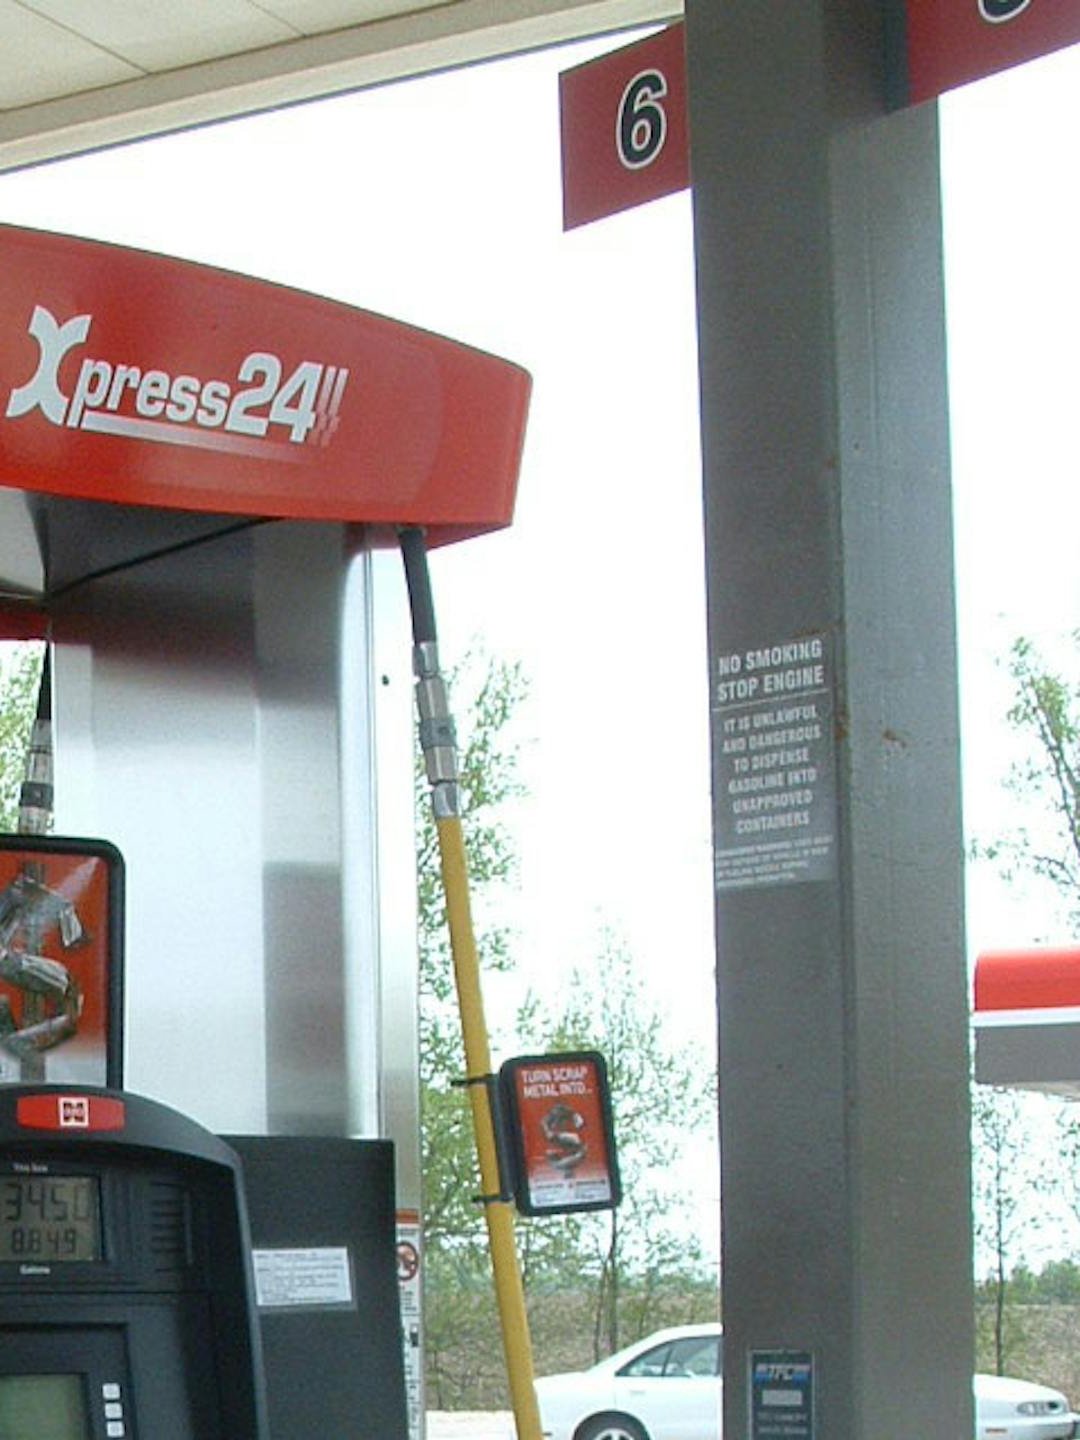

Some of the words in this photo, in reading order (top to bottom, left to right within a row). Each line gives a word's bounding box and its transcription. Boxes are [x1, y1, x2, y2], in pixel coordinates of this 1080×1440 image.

[616, 68, 667, 170] 6
[719, 655, 741, 676] NO
[746, 640, 822, 670] SMOKING
[718, 678, 758, 702] STOP
[764, 665, 824, 693] ENGINE
[753, 705, 817, 729] UNLAWFUL
[723, 737, 746, 753] AND
[749, 725, 821, 750] DANGEROUS
[734, 758, 749, 774] TO
[752, 748, 809, 771] DISPENSE
[728, 772, 784, 794] GASOLINE
[787, 768, 816, 786] INTO
[733, 789, 813, 813] UNAPPROVED
[737, 812, 809, 834] CONTAINERS
[522, 1069, 552, 1083] TURN
[553, 1066, 588, 1081] SCRAP
[524, 1084, 559, 1098] METAL
